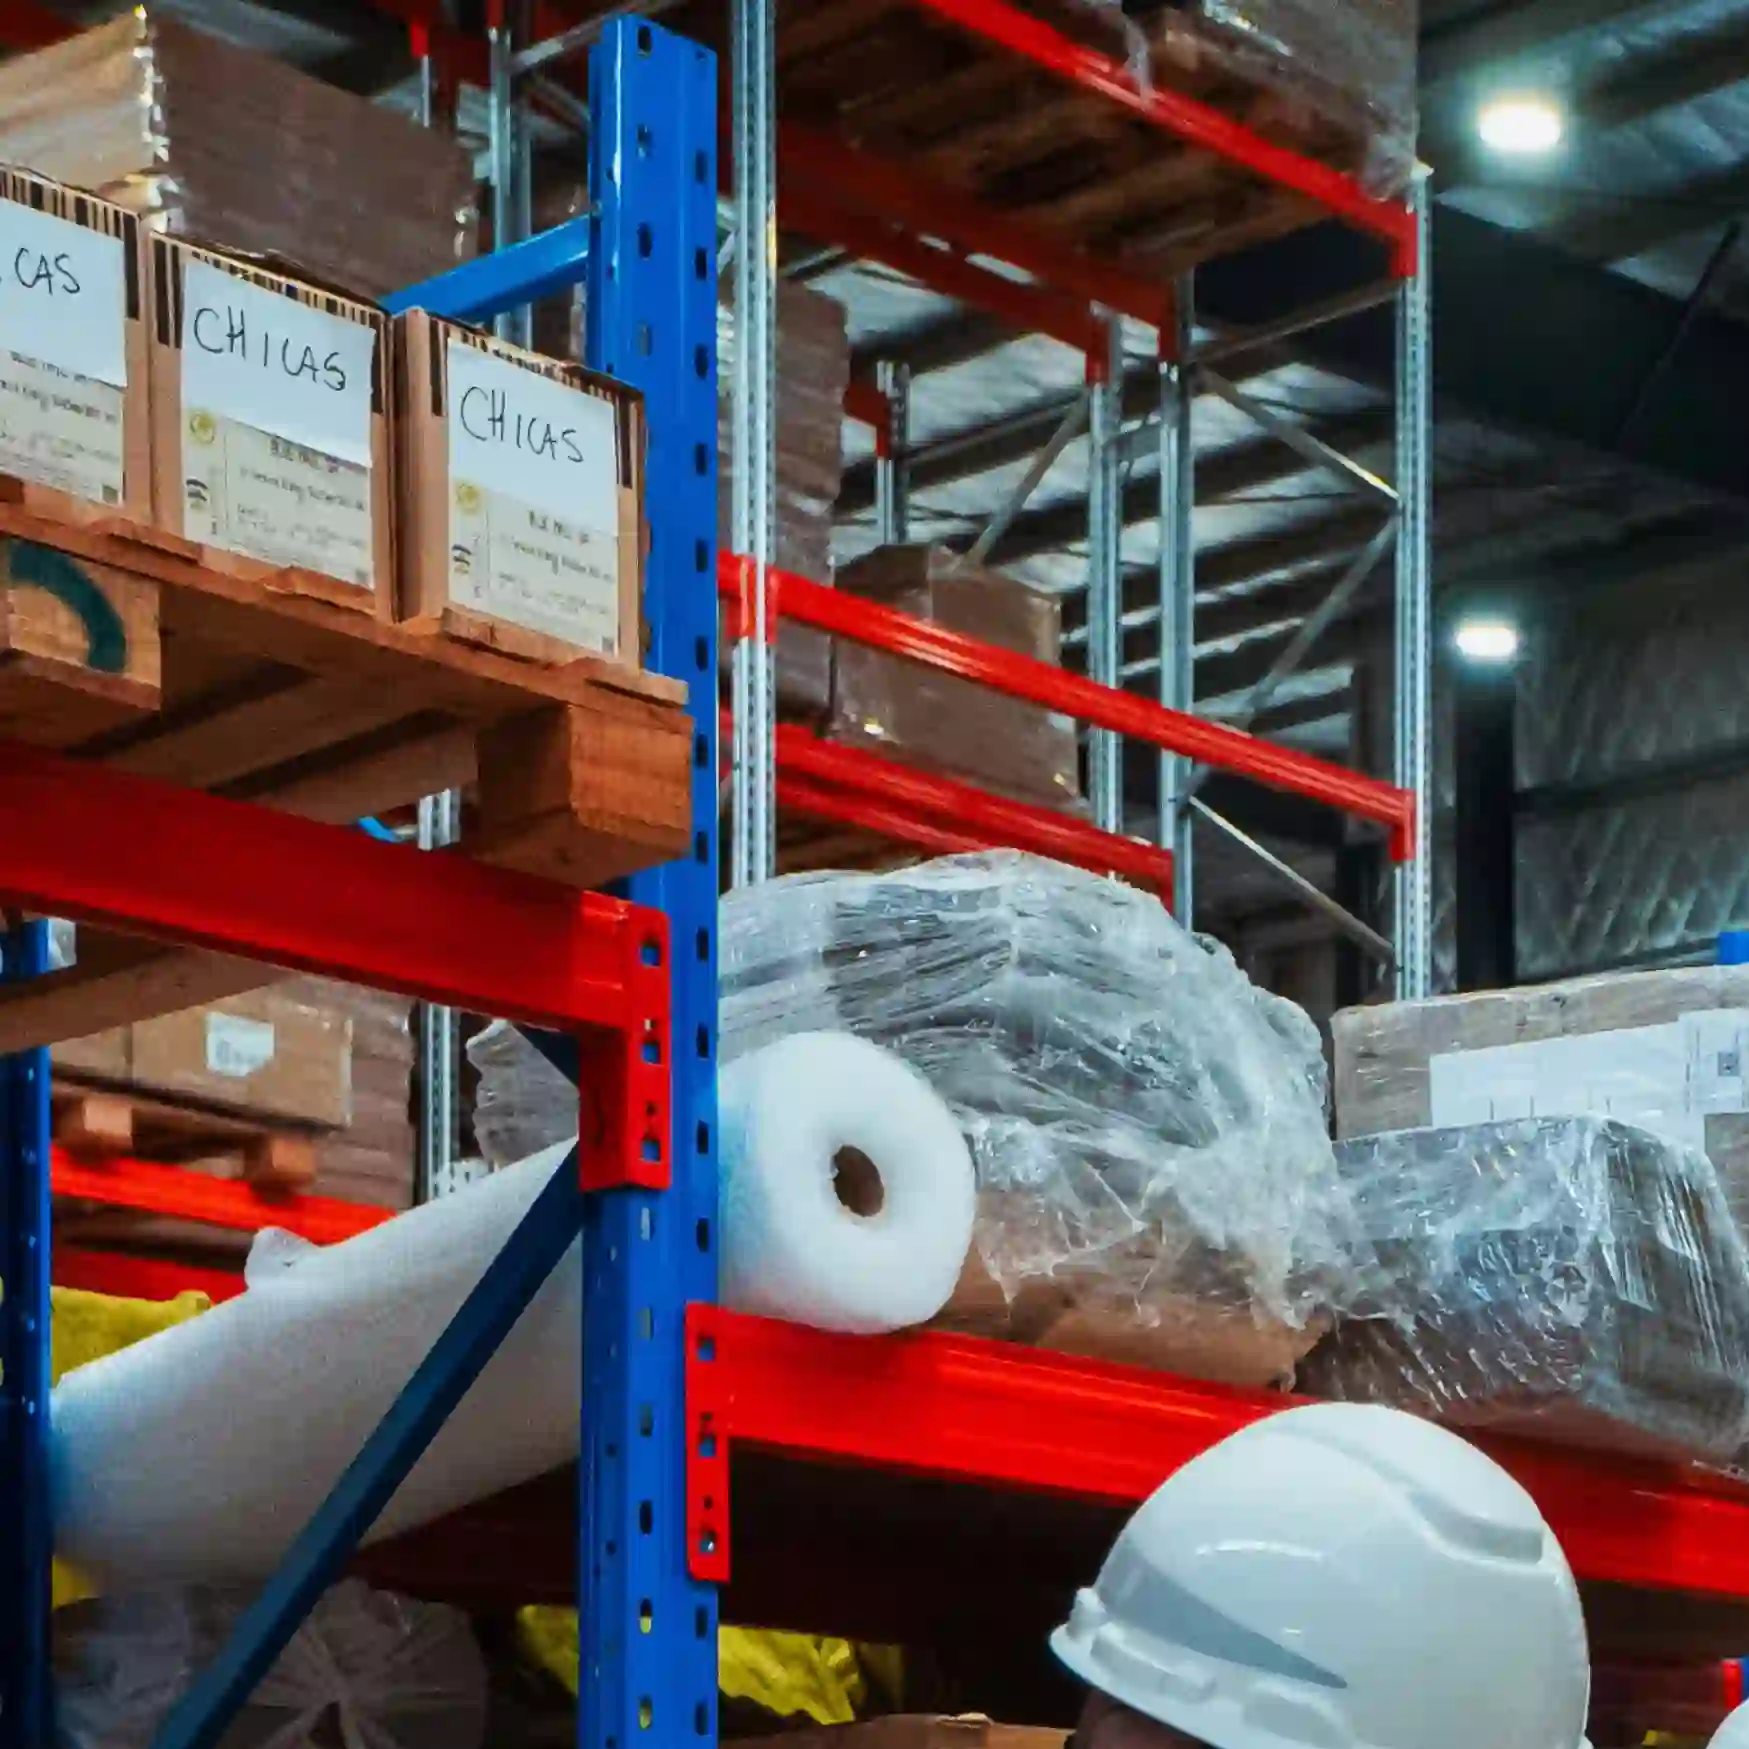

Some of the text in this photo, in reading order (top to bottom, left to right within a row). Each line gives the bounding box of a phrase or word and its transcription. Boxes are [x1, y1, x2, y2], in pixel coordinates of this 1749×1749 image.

[0, 246, 80, 295] CAS
[192, 304, 347, 391] CHICAS
[460, 385, 584, 463] CHICAS
